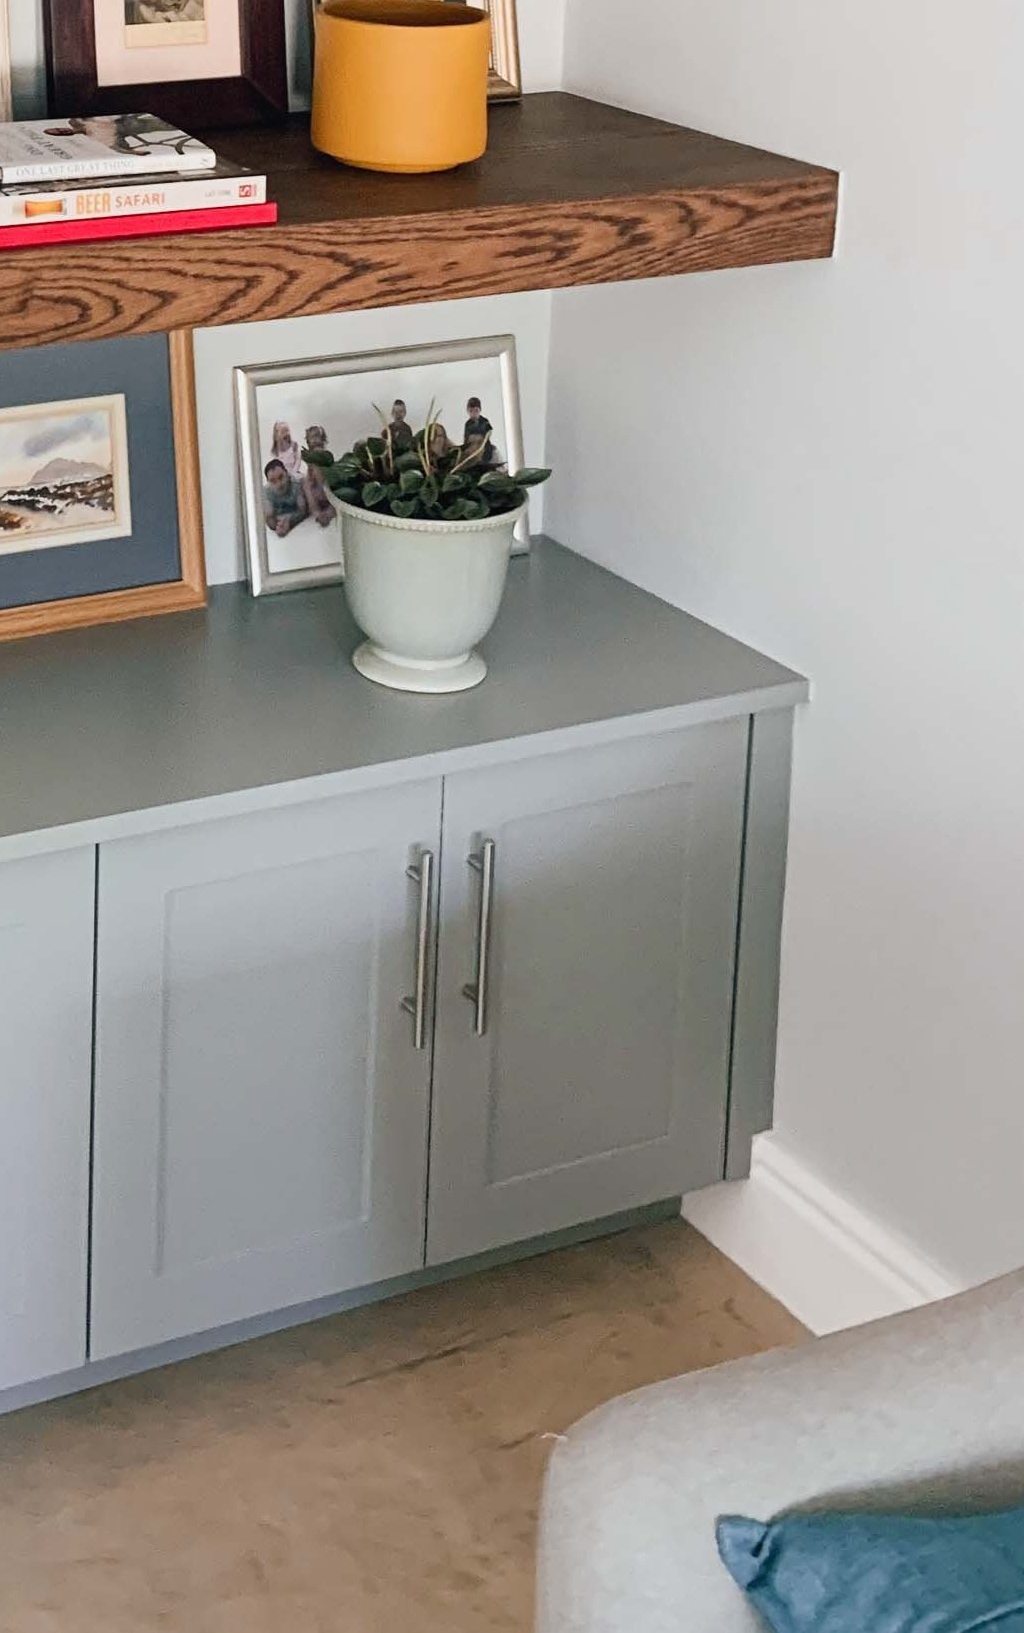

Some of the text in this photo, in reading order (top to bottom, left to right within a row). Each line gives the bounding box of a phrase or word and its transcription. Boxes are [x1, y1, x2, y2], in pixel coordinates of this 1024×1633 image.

[103, 159, 135, 171] THING
[76, 192, 165, 215] BEER SAFARI
